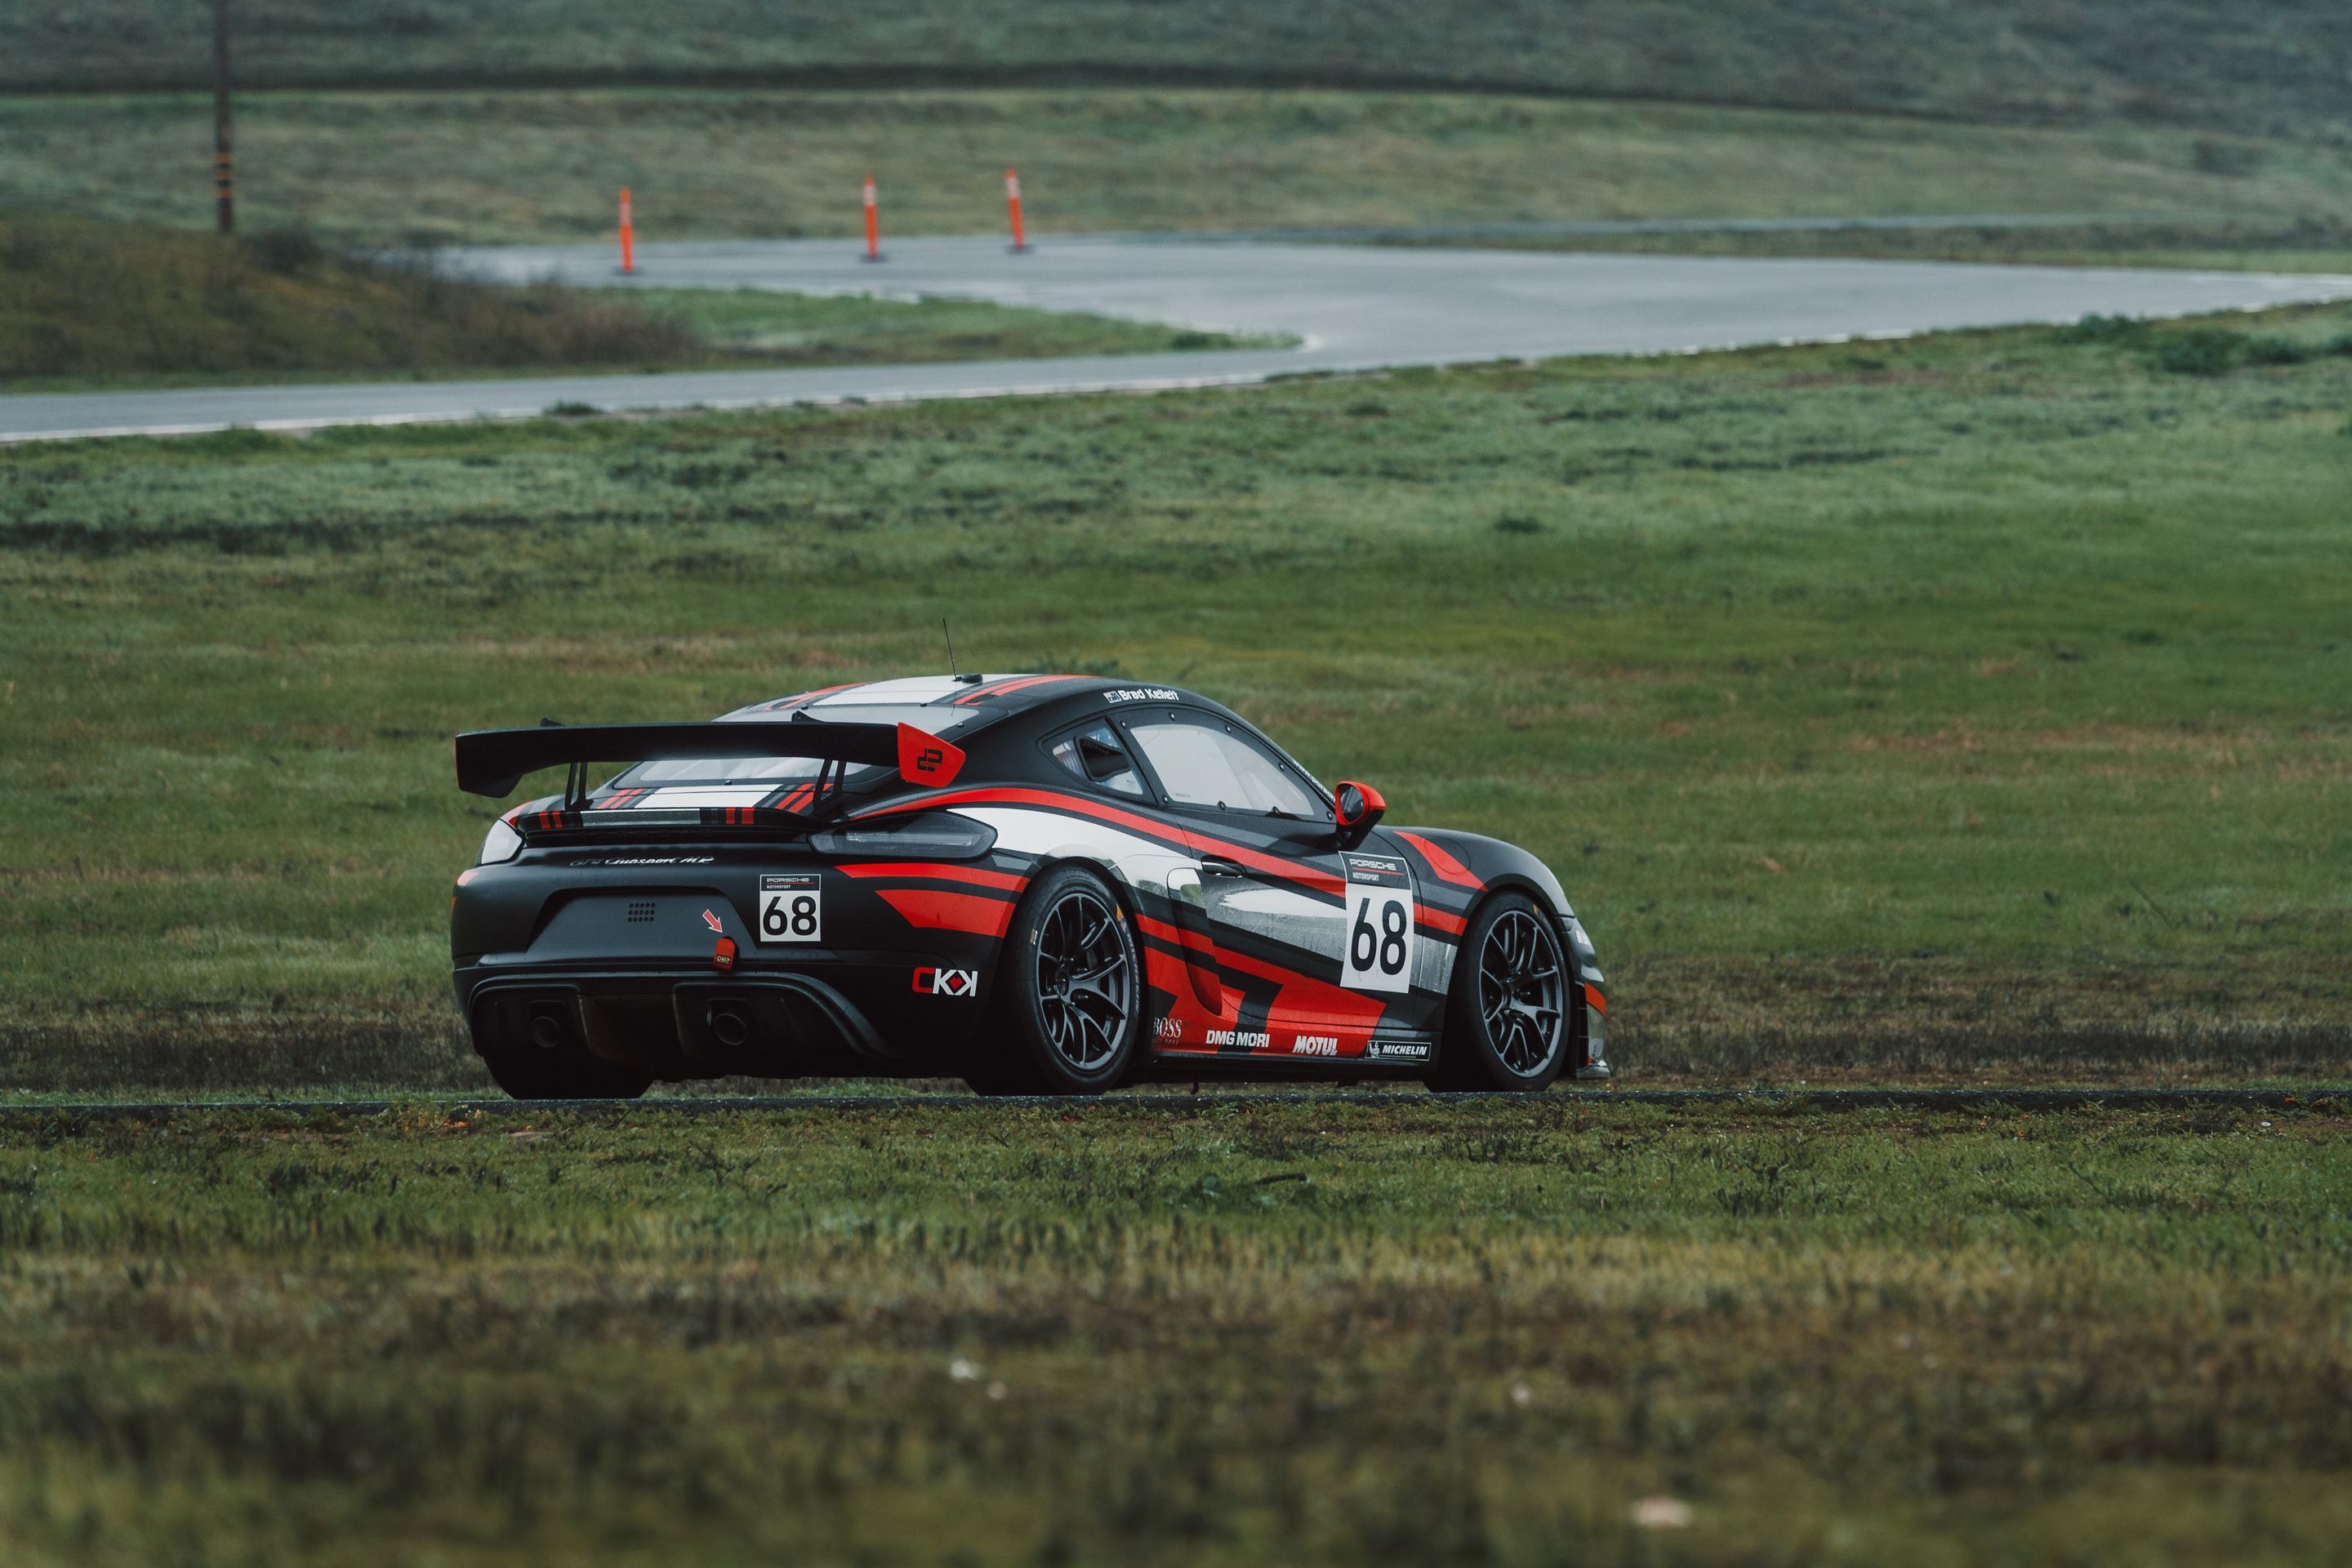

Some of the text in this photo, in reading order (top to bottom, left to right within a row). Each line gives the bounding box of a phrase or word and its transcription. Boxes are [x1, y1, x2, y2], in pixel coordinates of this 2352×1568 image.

[1117, 689, 1145, 701] Brad
[1349, 858, 1397, 871] PORSCHE
[1352, 871, 1379, 882] MOTORSPORT
[763, 895, 817, 936] 68
[1351, 898, 1406, 976] 68
[1152, 1017, 1183, 1039] BOSS
[1205, 1029, 1271, 1048] DMG MORI
[1292, 1036, 1339, 1056] MOTUL
[1382, 1045, 1428, 1056] MICHELIN
